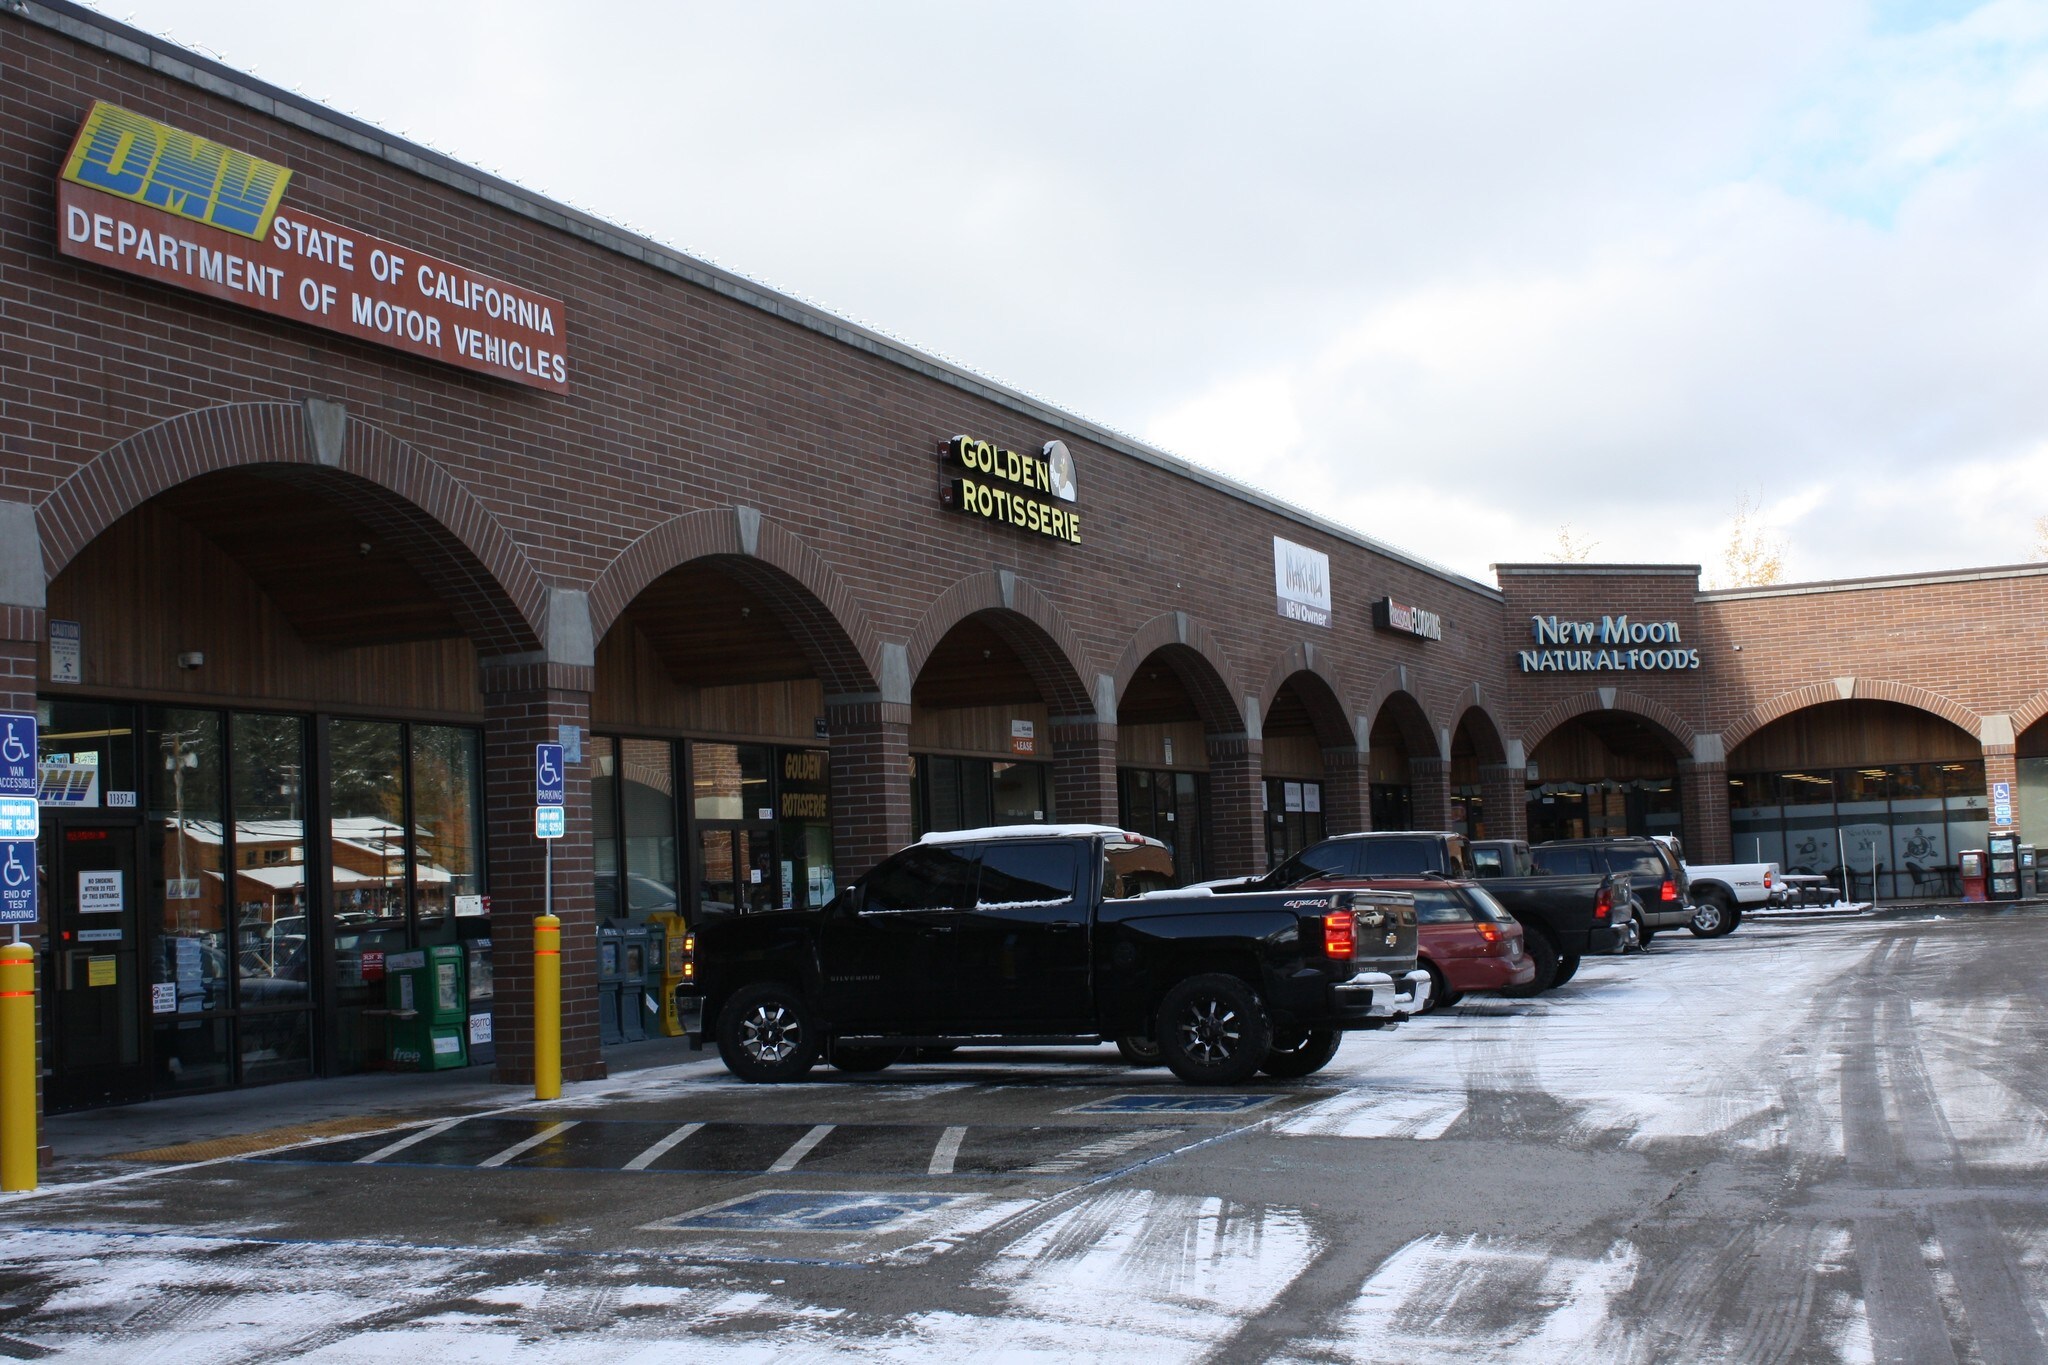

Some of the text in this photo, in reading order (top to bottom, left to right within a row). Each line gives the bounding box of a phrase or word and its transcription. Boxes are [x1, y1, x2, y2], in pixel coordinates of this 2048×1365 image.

[76, 104, 290, 235] DMV
[273, 215, 555, 336] STATE OF CALIFORNIA
[67, 204, 566, 384] DEPARTMENT OF MOTOR VEHICLES
[960, 435, 1050, 493] GOLDEN
[962, 478, 1082, 544] ROTISSERIE
[1286, 600, 1328, 627] NEW Owner
[51, 622, 79, 640] CAUTION
[1410, 606, 1442, 641] FLOORING
[1532, 614, 1682, 645] New Moon
[1519, 648, 1700, 673] NATURAL FOODS
[1016, 740, 1033, 752] LEASE
[10, 766, 24, 777] VAN
[785, 753, 821, 780] GOLDEN
[0, 778, 36, 789] ACCESSIBLE
[538, 789, 562, 801] PARKING
[782, 793, 827, 818] ROTISSERIE
[4, 889, 31, 899] END OF
[99, 892, 120, 900] ENTRANCE
[8, 900, 27, 909] TEST
[1, 910, 34, 919] PARKING
[477, 938, 492, 947] FREE
[470, 1014, 491, 1029] sierra
[392, 1047, 421, 1063] free
